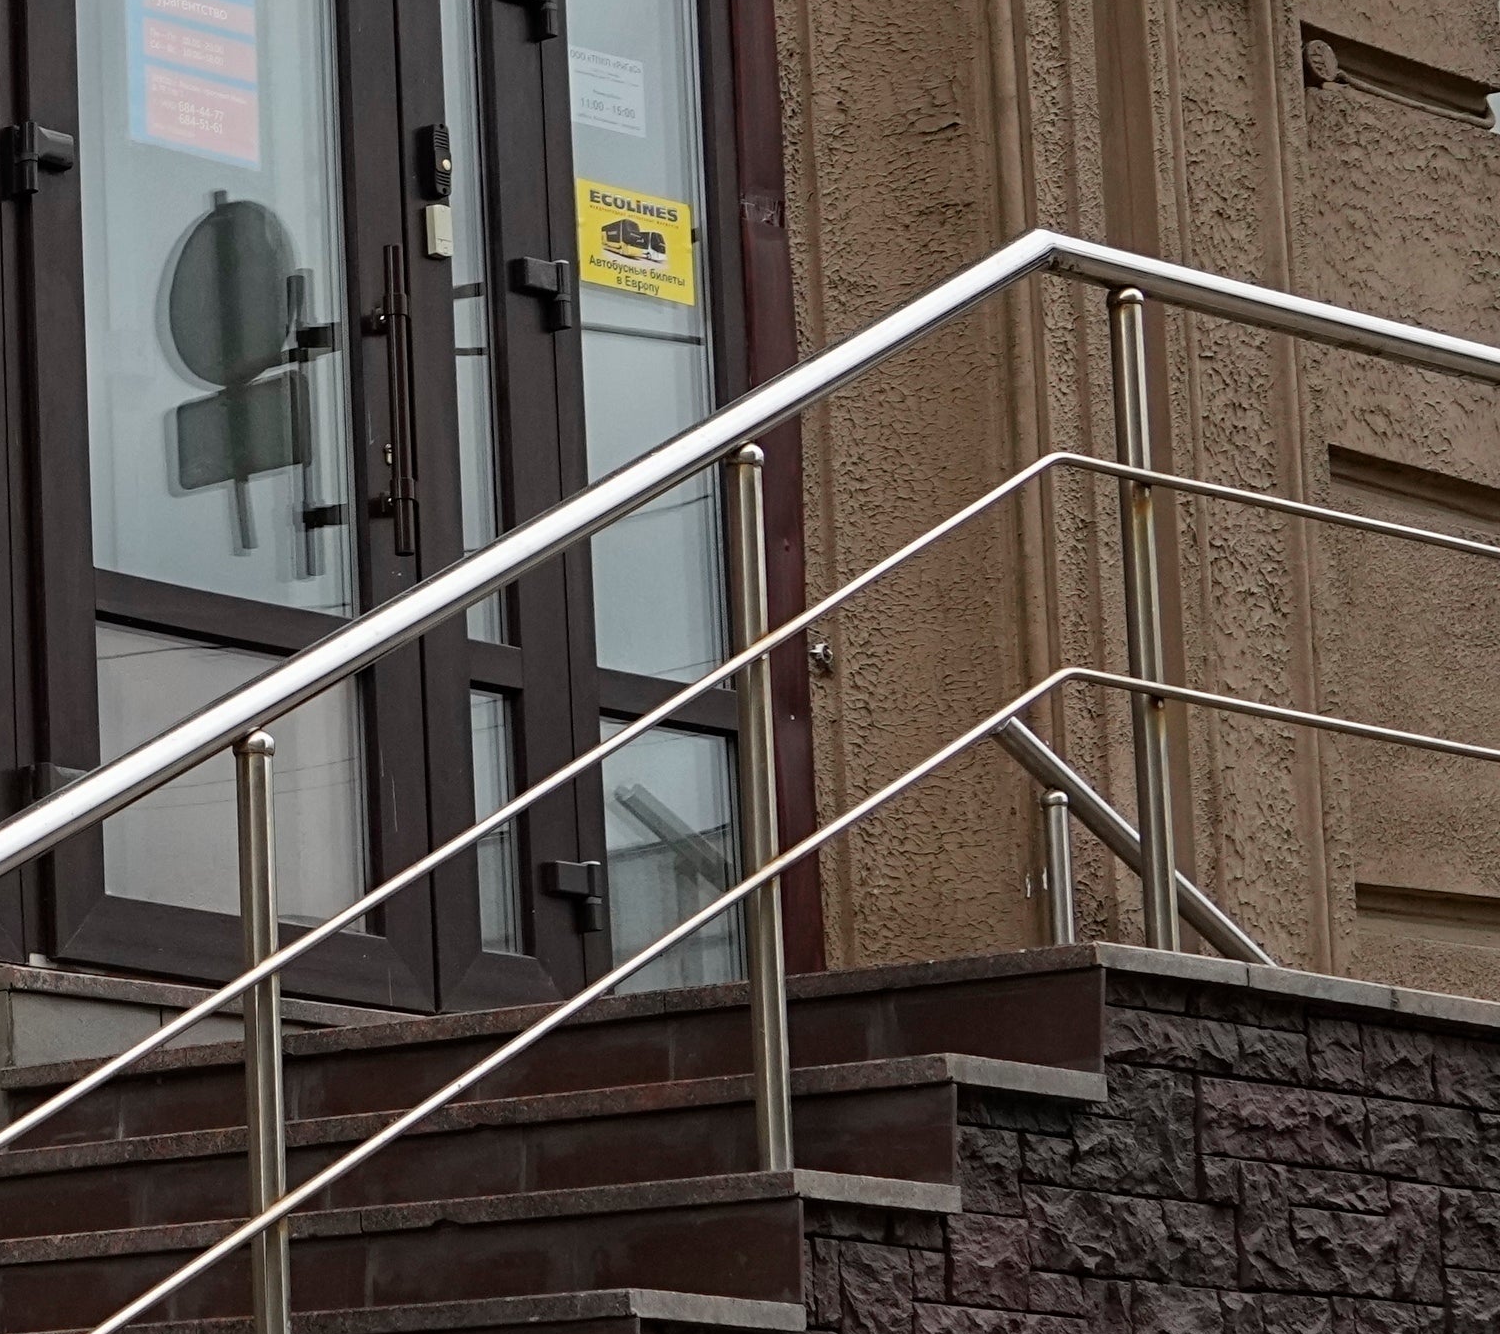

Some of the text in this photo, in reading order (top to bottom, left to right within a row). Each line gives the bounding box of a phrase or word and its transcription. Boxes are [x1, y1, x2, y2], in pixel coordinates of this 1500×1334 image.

[589, 254, 685, 287] Автобусные билеты
[616, 275, 660, 295] в Европу
